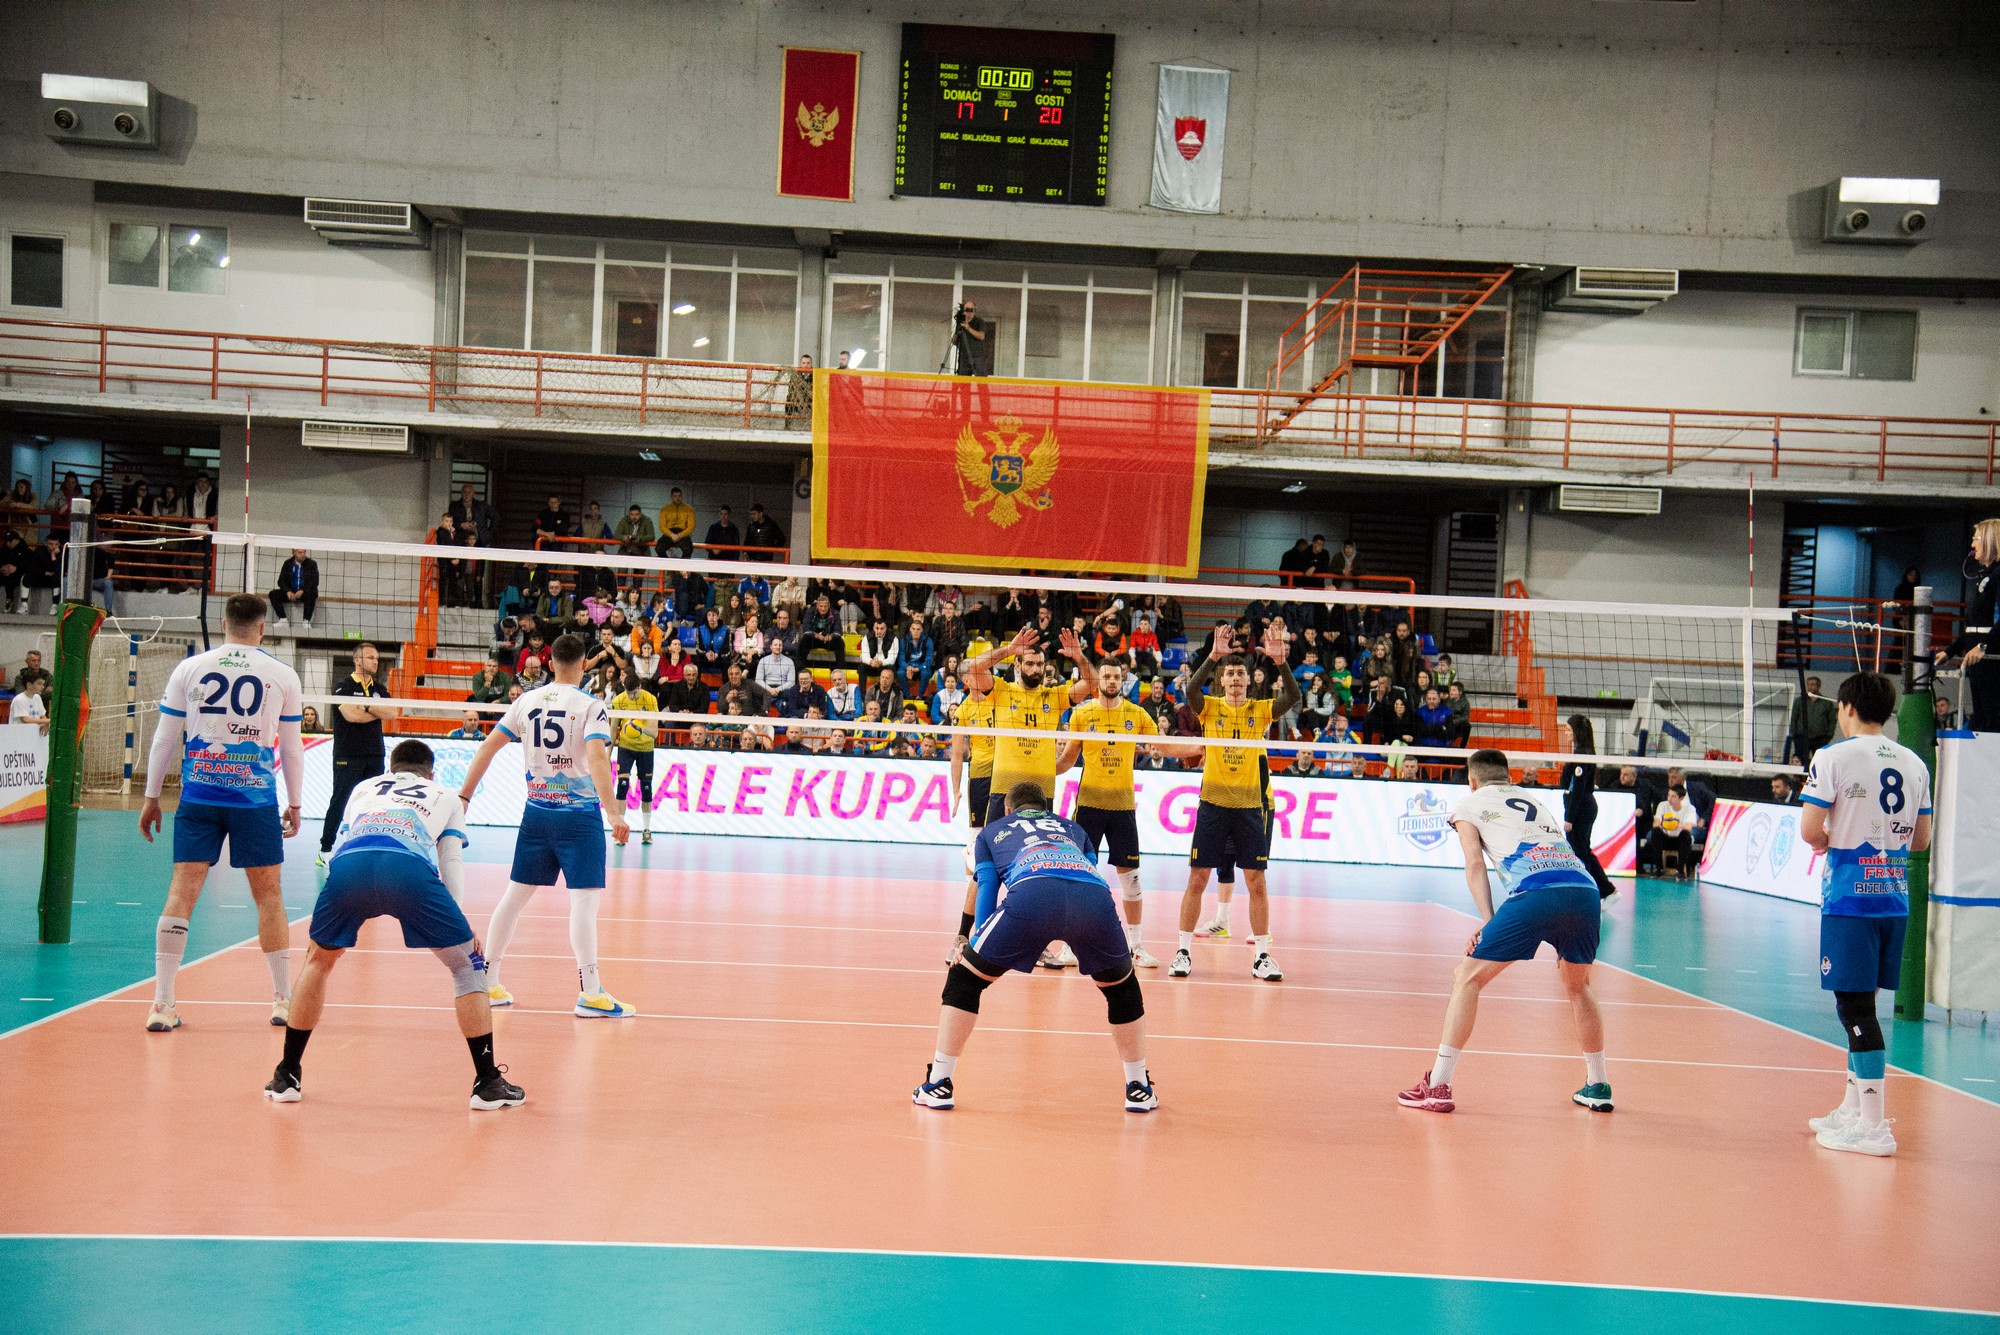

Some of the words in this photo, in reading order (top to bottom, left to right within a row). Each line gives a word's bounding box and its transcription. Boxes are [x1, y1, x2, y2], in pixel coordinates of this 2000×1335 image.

[904, 60, 909, 68] 4
[904, 71, 909, 79] 5
[980, 70, 1031, 88] 00:00
[1106, 71, 1111, 79] 4
[903, 81, 908, 89] 6
[1105, 82, 1111, 90] 5
[903, 92, 908, 100] 7
[944, 88, 981, 101] DOMAĆI
[1105, 92, 1110, 100] 6
[1035, 94, 1064, 106] GOSTI
[903, 103, 907, 111] 8
[958, 102, 974, 119] 17
[1104, 103, 1109, 111] 7
[902, 113, 907, 121] 9
[1004, 108, 1008, 121] 1
[1039, 107, 1062, 124] 20
[1104, 114, 1109, 122] 8
[898, 124, 906, 132] 10
[1103, 124, 1108, 132] 9
[897, 134, 906, 142] 11
[1099, 135, 1108, 143] 10
[897, 145, 905, 153] 12
[896, 156, 905, 164] 13
[1098, 156, 1107, 164] 12
[896, 166, 905, 174] 14
[895, 177, 904, 185] 15
[1097, 177, 1105, 185] 14
[939, 182, 951, 190] SET
[977, 184, 988, 192] SET
[1046, 188, 1057, 196] SET
[1096, 188, 1105, 196] 15
[199, 672, 264, 717] 20
[1024, 713, 1037, 727] 14
[528, 708, 566, 749] 15
[4, 751, 36, 768] OPŠTINA
[194, 761, 253, 776] FRANCA
[23, 771, 44, 786] POLJE
[375, 780, 428, 799] 16
[1880, 768, 1905, 815] 8
[783, 766, 954, 823] KUPA
[1158, 784, 1338, 840] GRE
[1505, 798, 1538, 822] 9
[1008, 819, 1066, 833] 18
